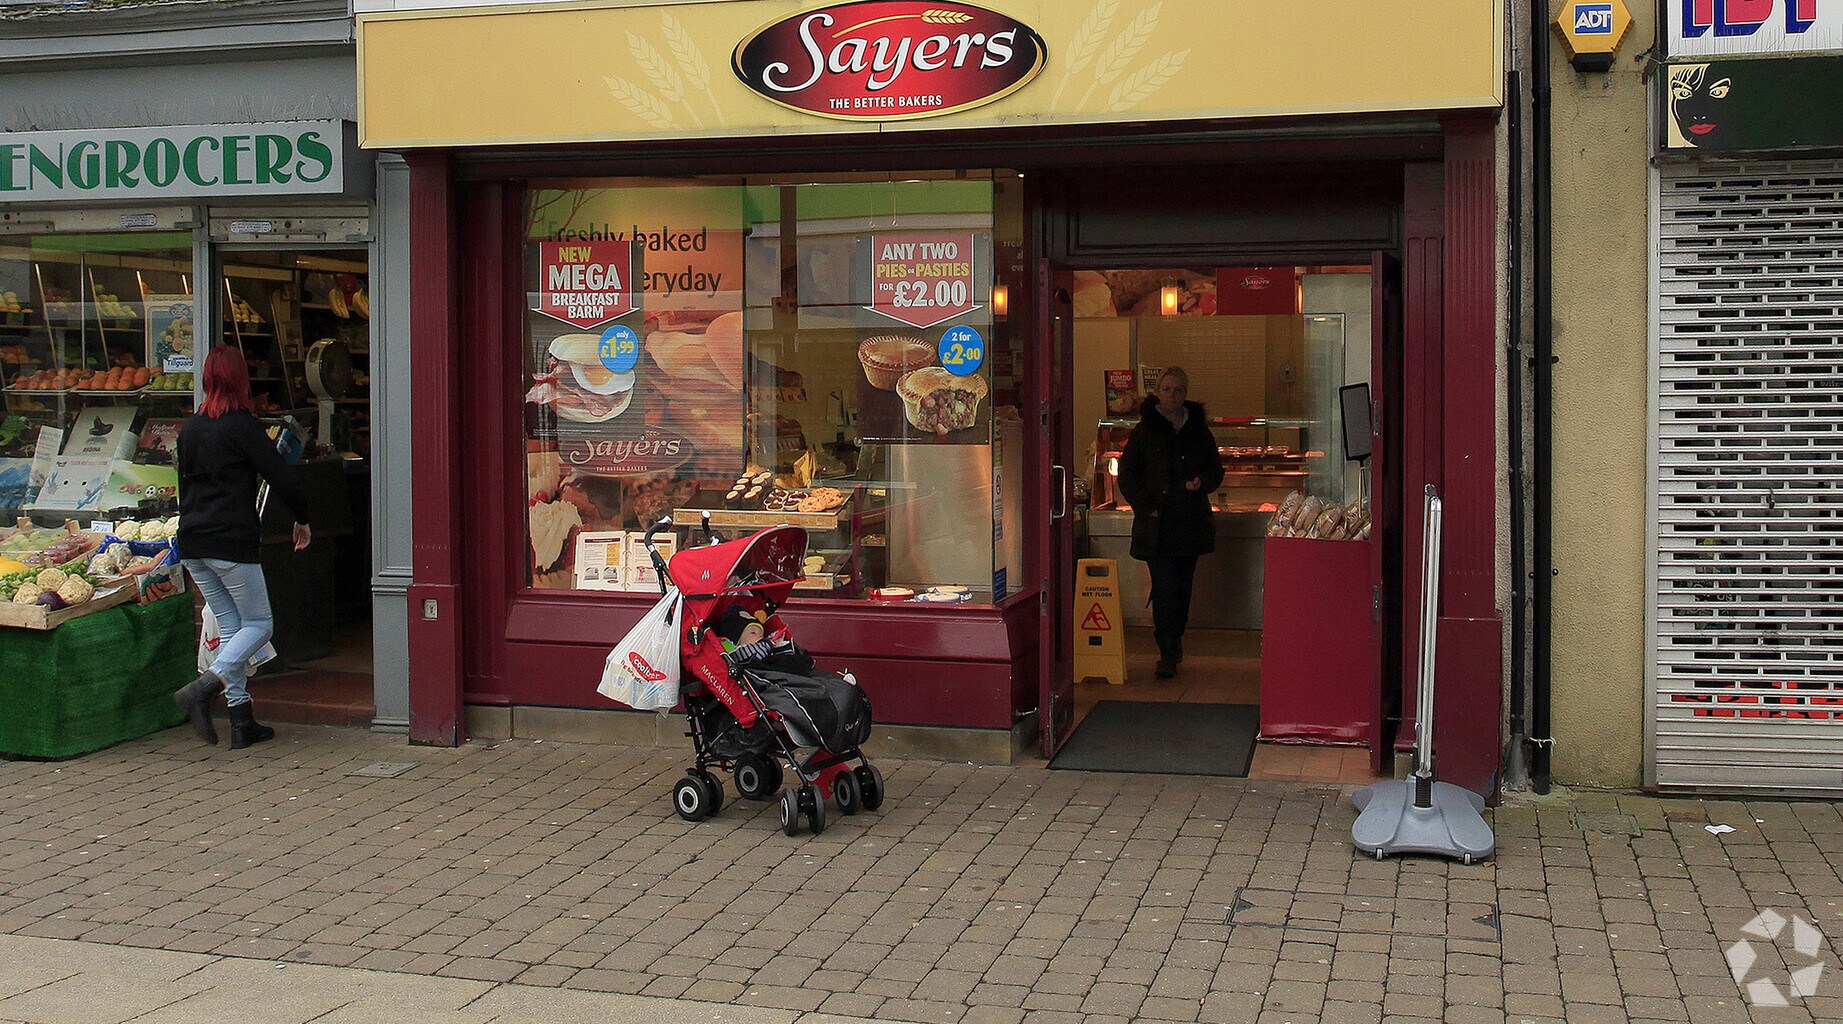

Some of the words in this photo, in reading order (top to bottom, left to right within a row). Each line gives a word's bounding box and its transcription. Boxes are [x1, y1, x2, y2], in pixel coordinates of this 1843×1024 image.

[1575, 9, 1611, 30] ADT
[762, 13, 1018, 92] Sayers
[829, 97, 851, 109] THE
[853, 96, 895, 108] BETTER
[898, 94, 943, 107] BAKERS
[0, 131, 333, 191] ENGROCERS
[633, 225, 707, 252] baked
[558, 247, 591, 263] NEW
[881, 243, 917, 261] ANY
[919, 242, 958, 259] TWO
[548, 263, 622, 291] MEGA
[876, 264, 907, 278] PIES
[915, 263, 970, 277] PASTIES
[643, 265, 722, 299] eryday
[552, 292, 620, 307] BREAKFAST
[879, 283, 894, 291] FOR
[893, 280, 967, 307] £2.00
[567, 306, 604, 319] BARM
[616, 330, 629, 340] only
[951, 332, 958, 341] 2
[958, 332, 972, 341] for
[701, 665, 734, 705] MACLAREN
